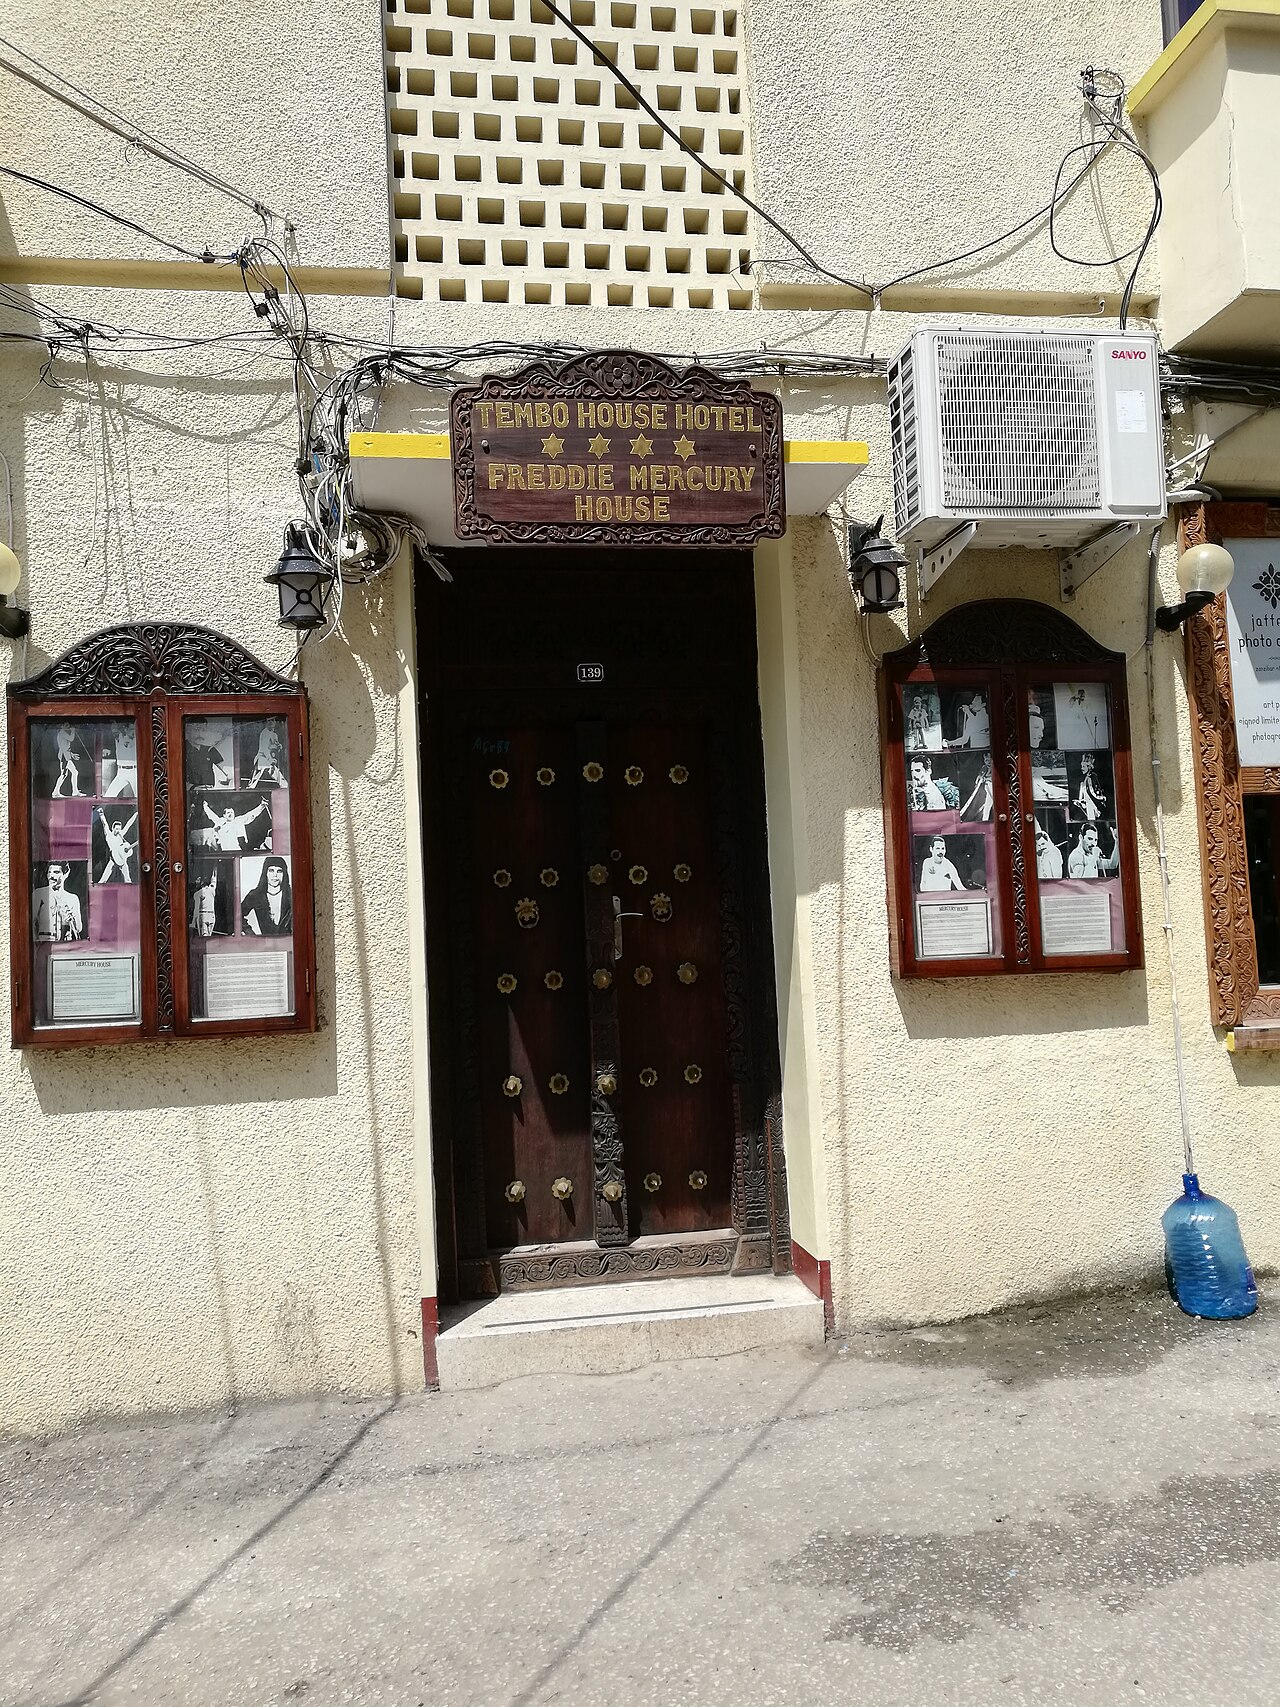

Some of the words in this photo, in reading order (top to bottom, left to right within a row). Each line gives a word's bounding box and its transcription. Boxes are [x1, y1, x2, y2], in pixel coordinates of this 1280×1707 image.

[1111, 350, 1147, 360] SANYO
[475, 402, 570, 429] TEMBO
[577, 403, 667, 430] HOUSE
[675, 404, 761, 432] HOTEL
[488, 463, 614, 490] FREDDIE
[630, 465, 755, 492] MERCURY
[575, 496, 670, 521] HOUSE
[1238, 633, 1272, 653] photo
[580, 667, 601, 678] 139
